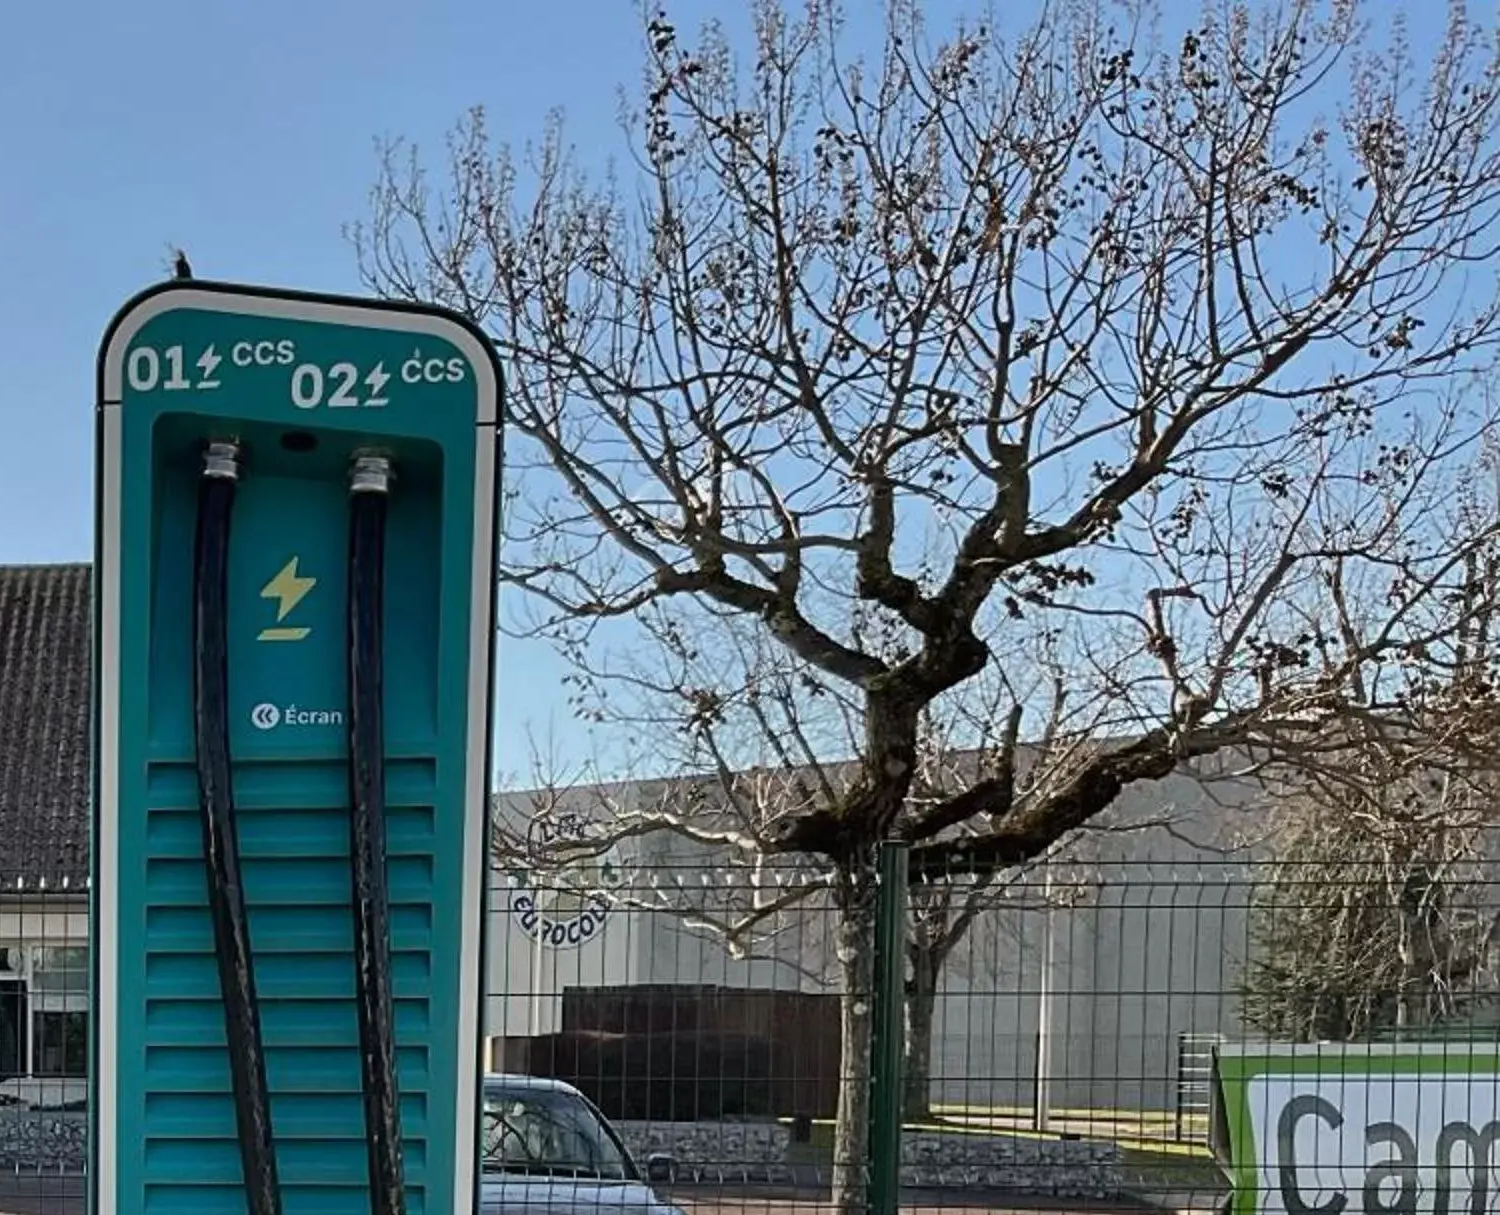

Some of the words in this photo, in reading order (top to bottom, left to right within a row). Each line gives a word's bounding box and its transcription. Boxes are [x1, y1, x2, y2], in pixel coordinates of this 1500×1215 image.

[127, 345, 190, 391] 01
[232, 340, 295, 366] CCS
[291, 362, 359, 409] 02
[401, 357, 465, 383] CCS
[285, 704, 342, 724] Écran
